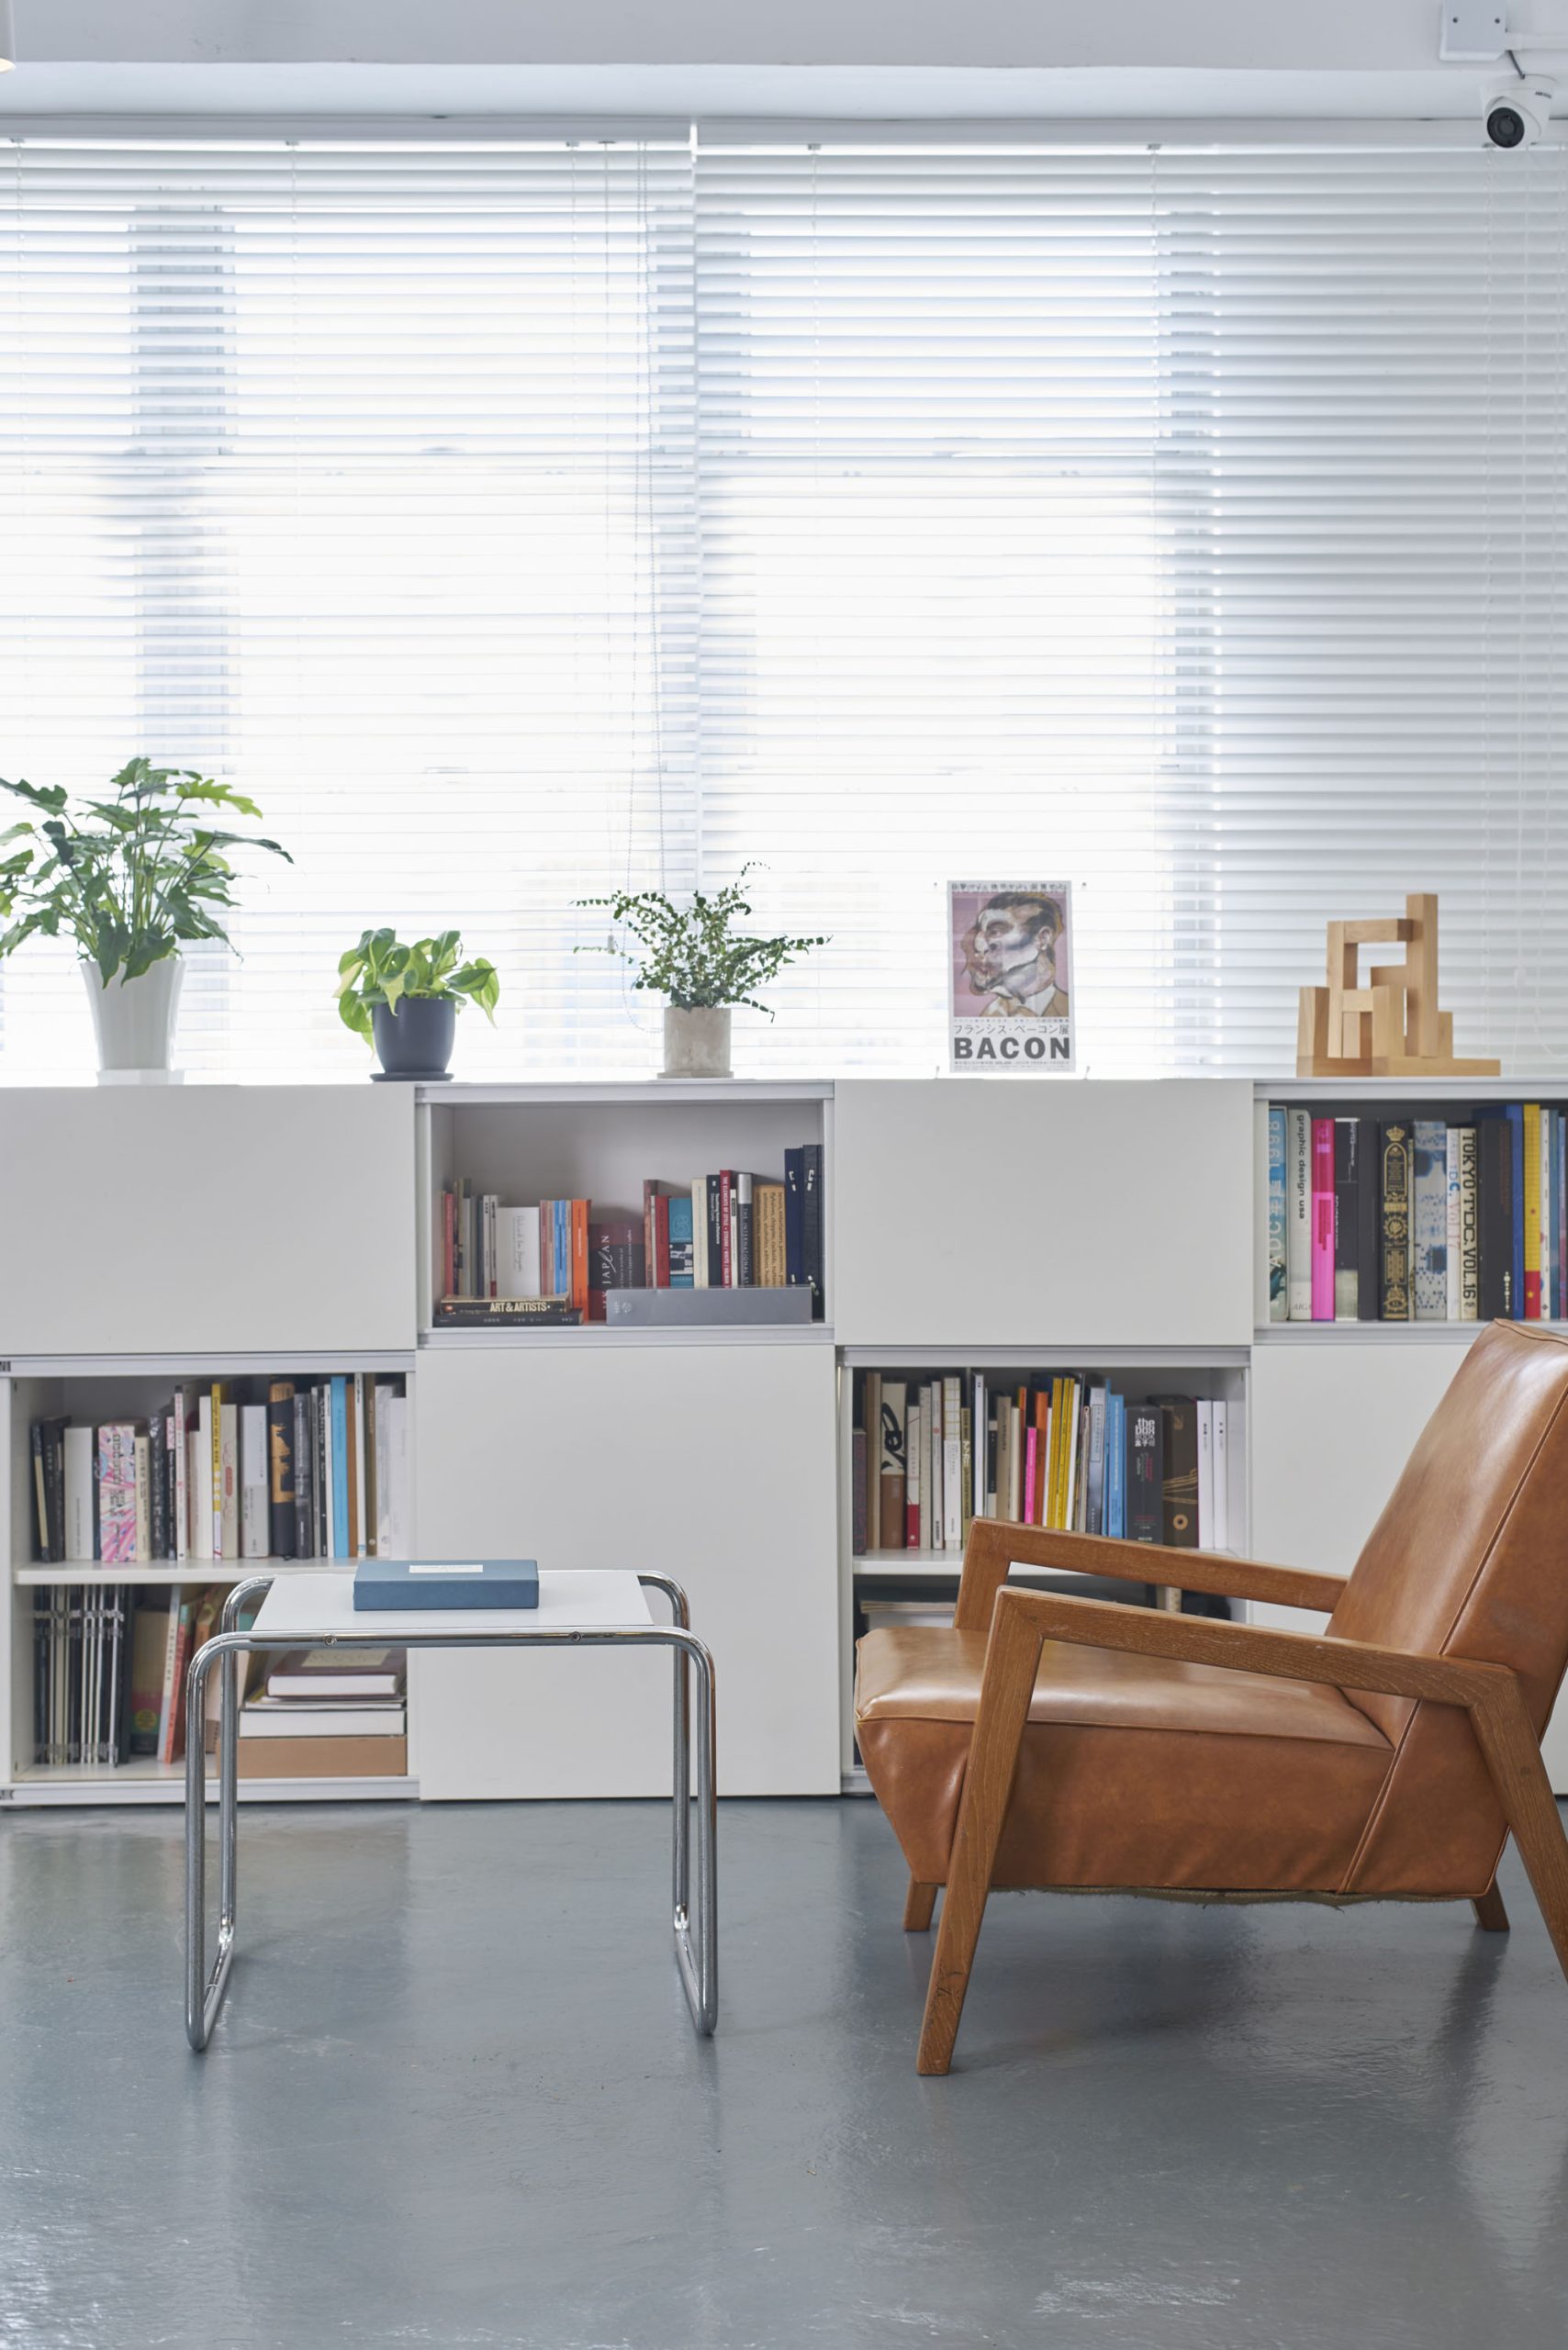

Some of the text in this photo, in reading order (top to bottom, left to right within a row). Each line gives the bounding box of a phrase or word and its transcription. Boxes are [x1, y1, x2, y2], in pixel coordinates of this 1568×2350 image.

[954, 1024, 1070, 1035] フランシス・ベーコン展
[954, 1036, 1070, 1059] BACON
[1296, 1114, 1306, 1219] graphic design usa
[1462, 1133, 1476, 1299] TOKYO TDC. VOL.16
[489, 1303, 504, 1312] ART
[506, 1303, 513, 1312] &
[514, 1302, 547, 1312] ARTISTS
[1137, 1417, 1156, 1427] the
[1135, 1425, 1156, 1434] box
